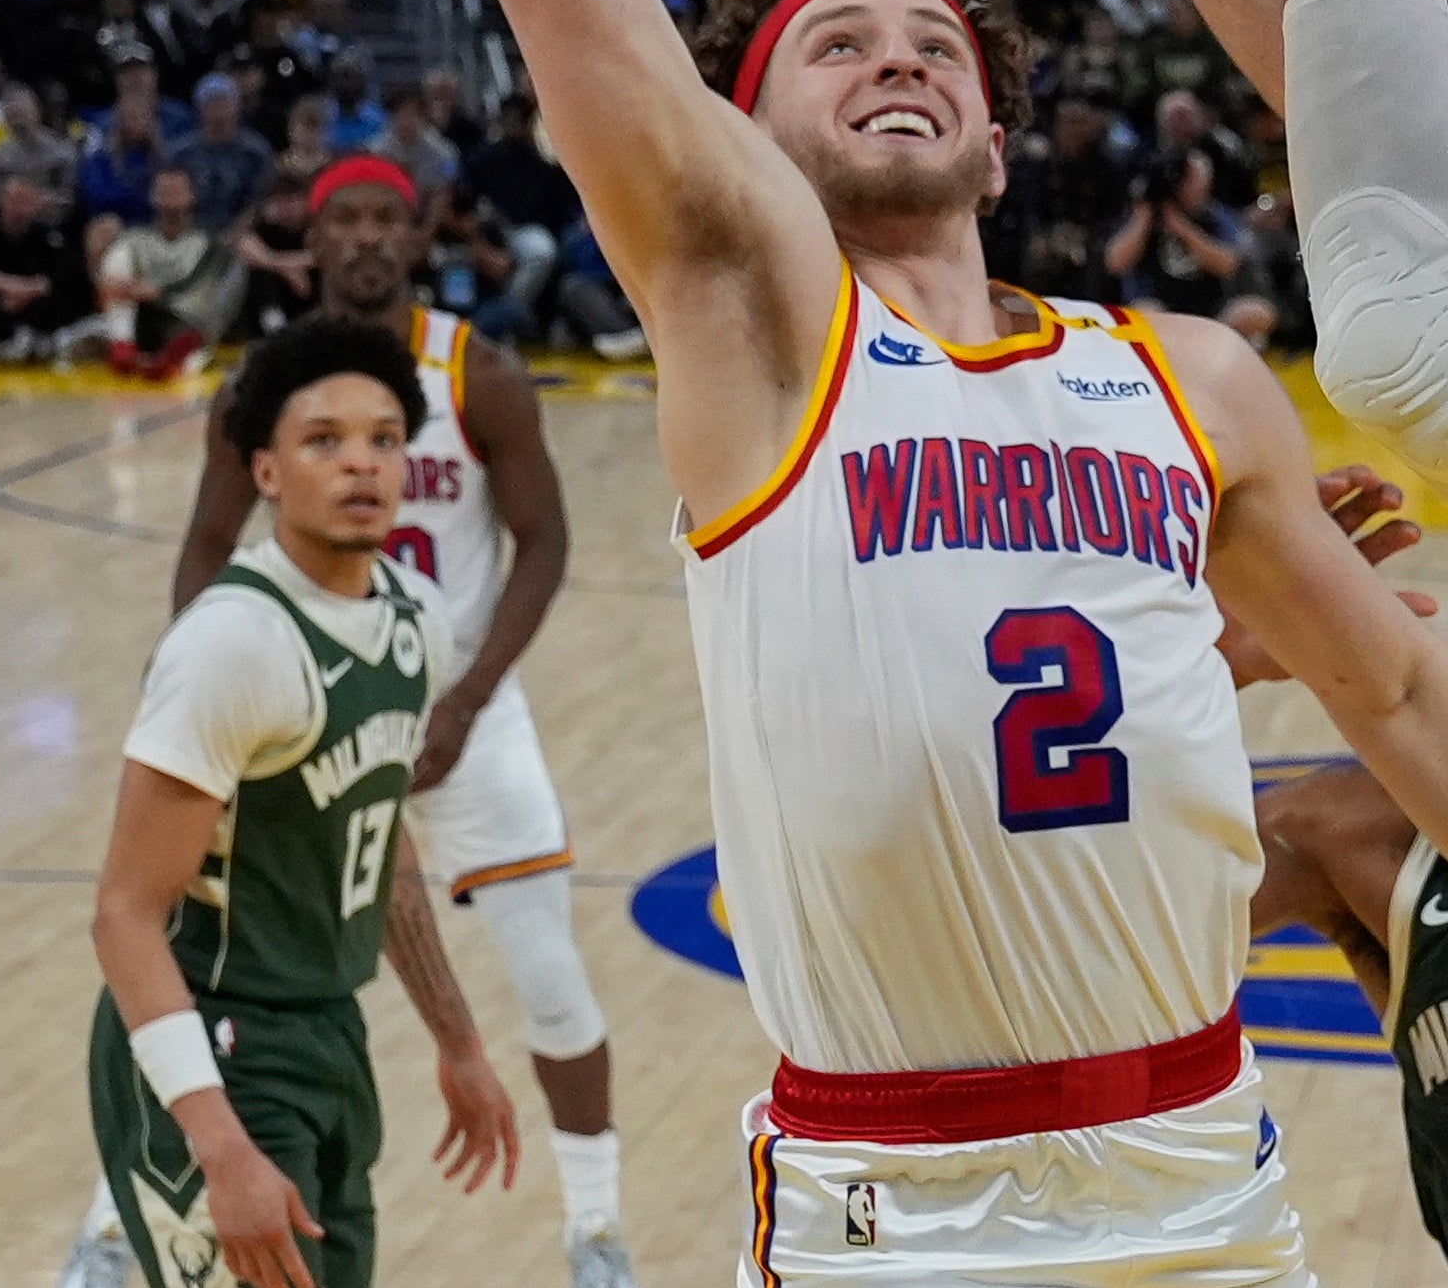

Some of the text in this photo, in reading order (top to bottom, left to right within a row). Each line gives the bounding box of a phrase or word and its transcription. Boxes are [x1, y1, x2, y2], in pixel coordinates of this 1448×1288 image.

[840, 438, 1203, 590] WARRIORS
[984, 605, 1130, 834] 2
[340, 797, 398, 921] 13
